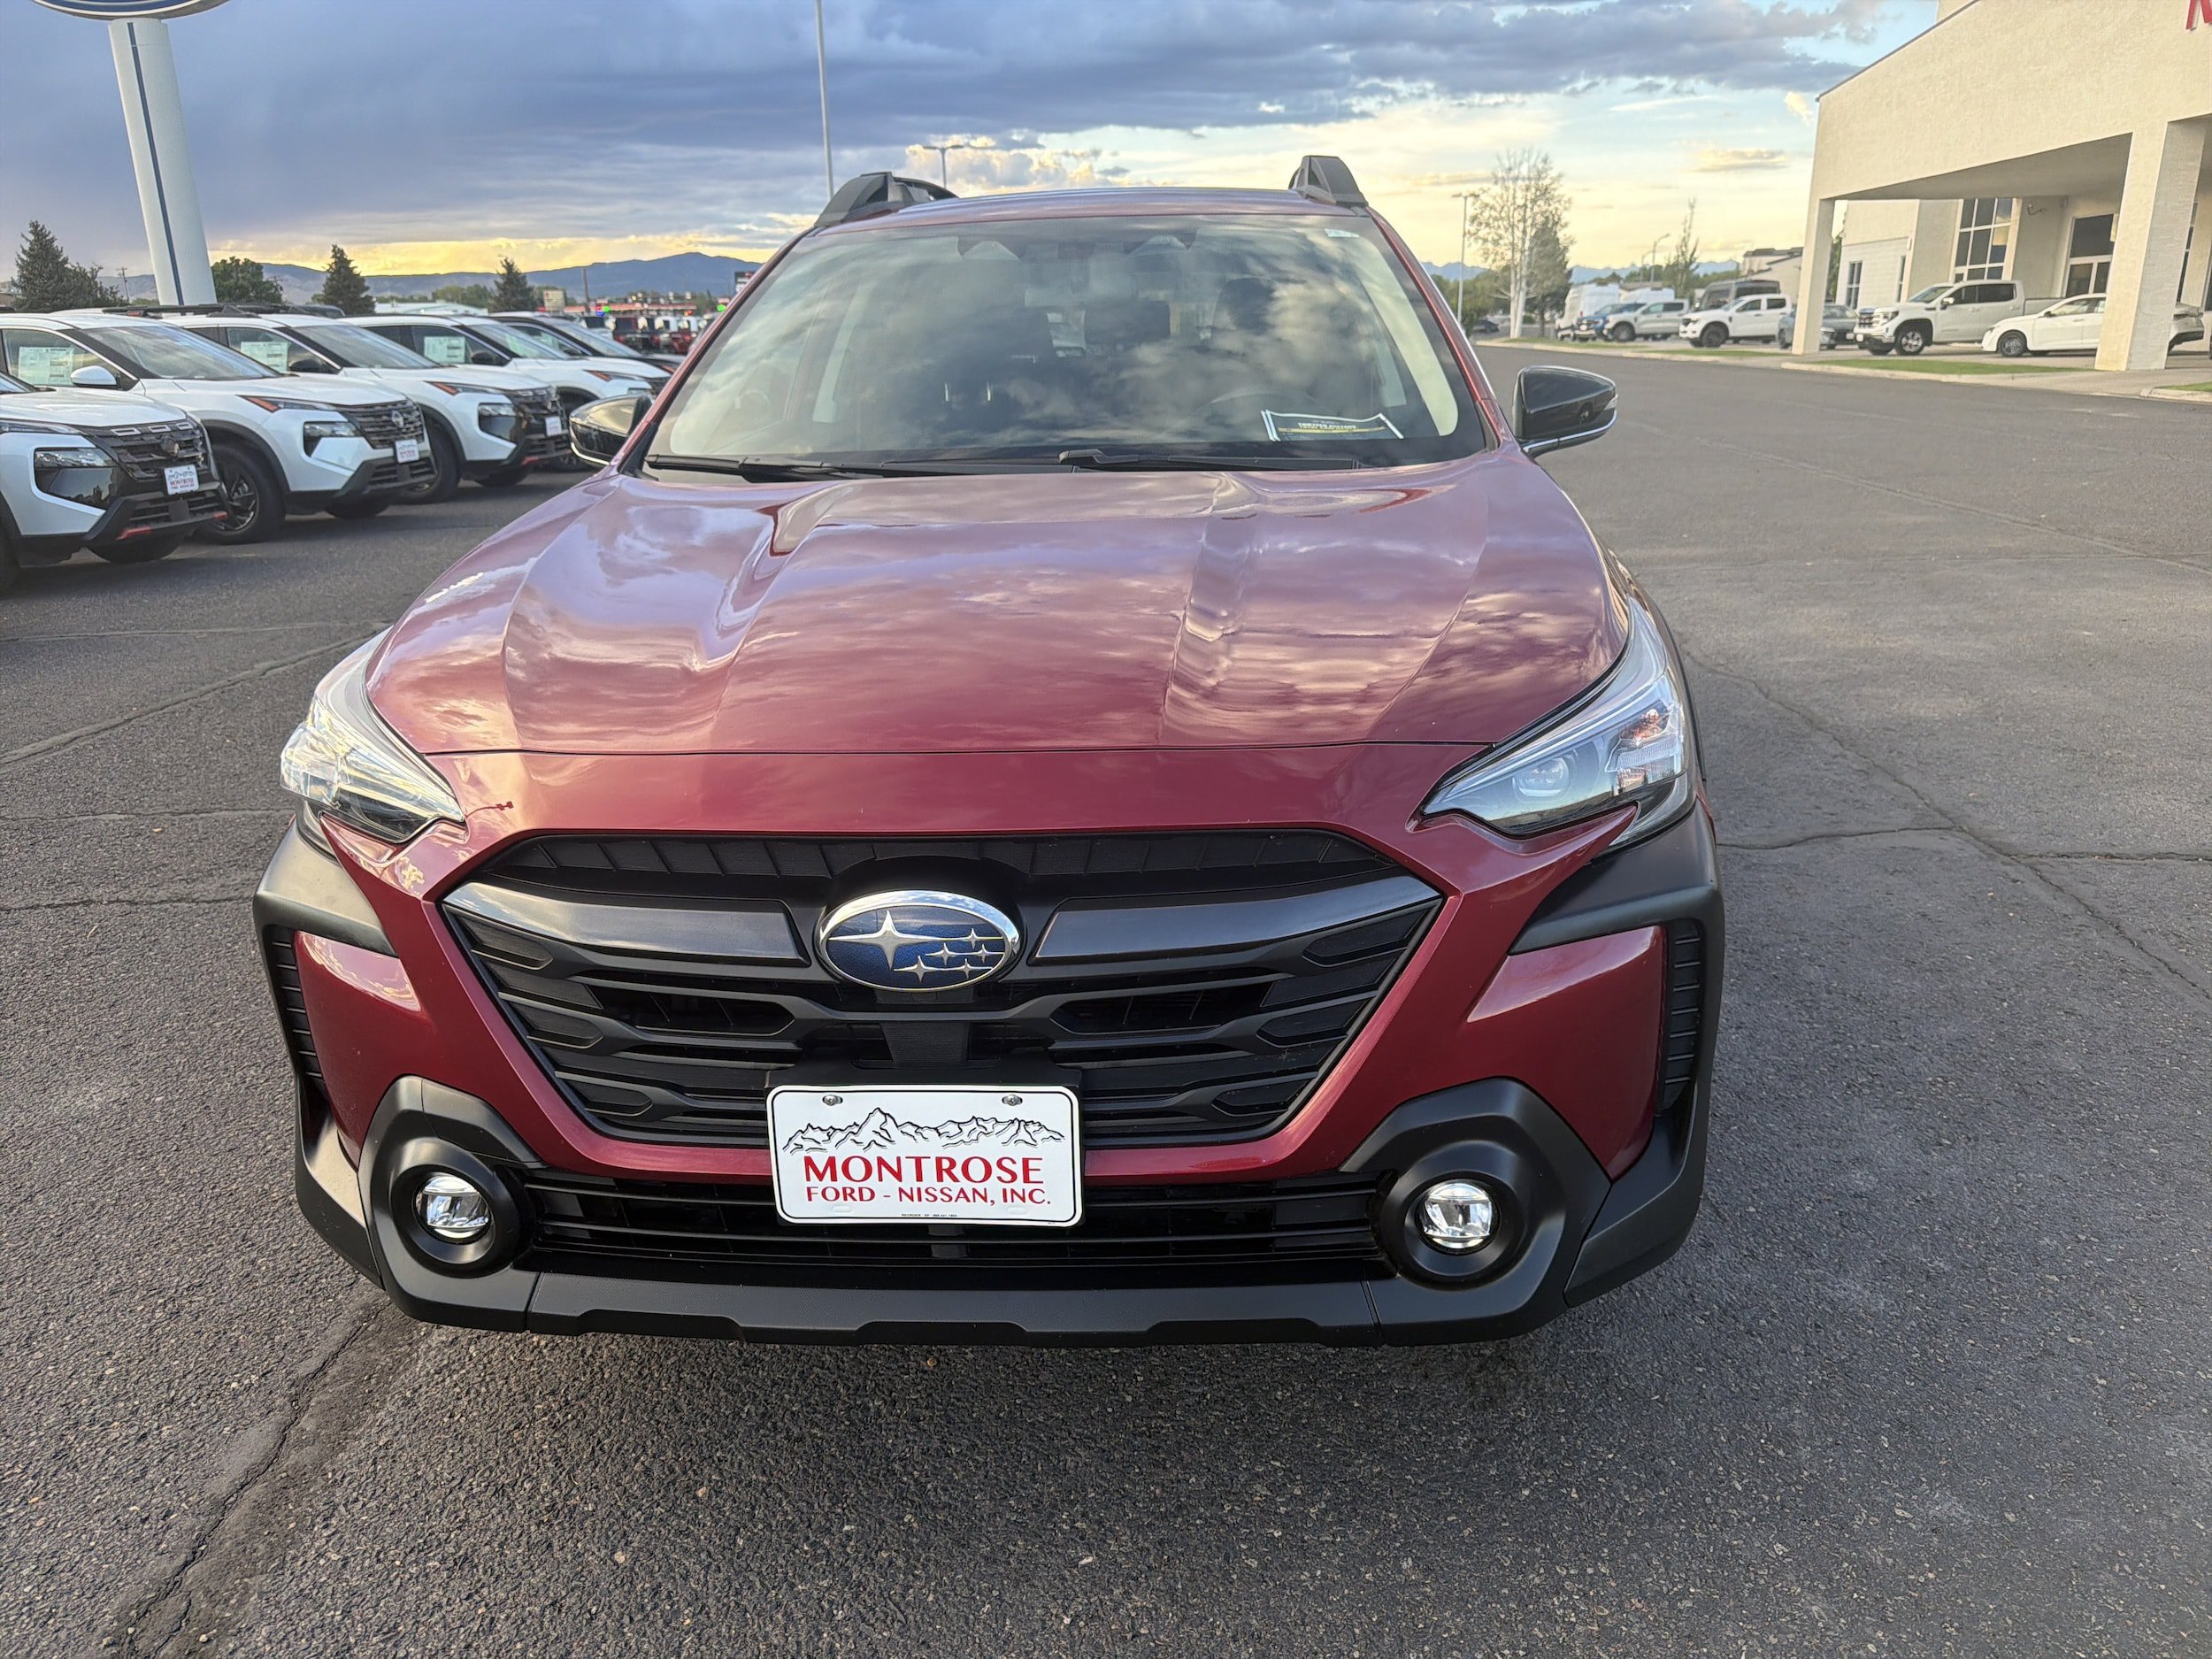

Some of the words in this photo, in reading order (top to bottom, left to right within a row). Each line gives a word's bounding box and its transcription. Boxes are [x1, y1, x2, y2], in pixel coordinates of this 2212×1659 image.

[803, 1156, 1044, 1184] MONTROSE
[806, 1187, 876, 1202] FORD
[898, 1187, 995, 1206] NISSAN,
[1002, 1188, 1051, 1204] INC.
